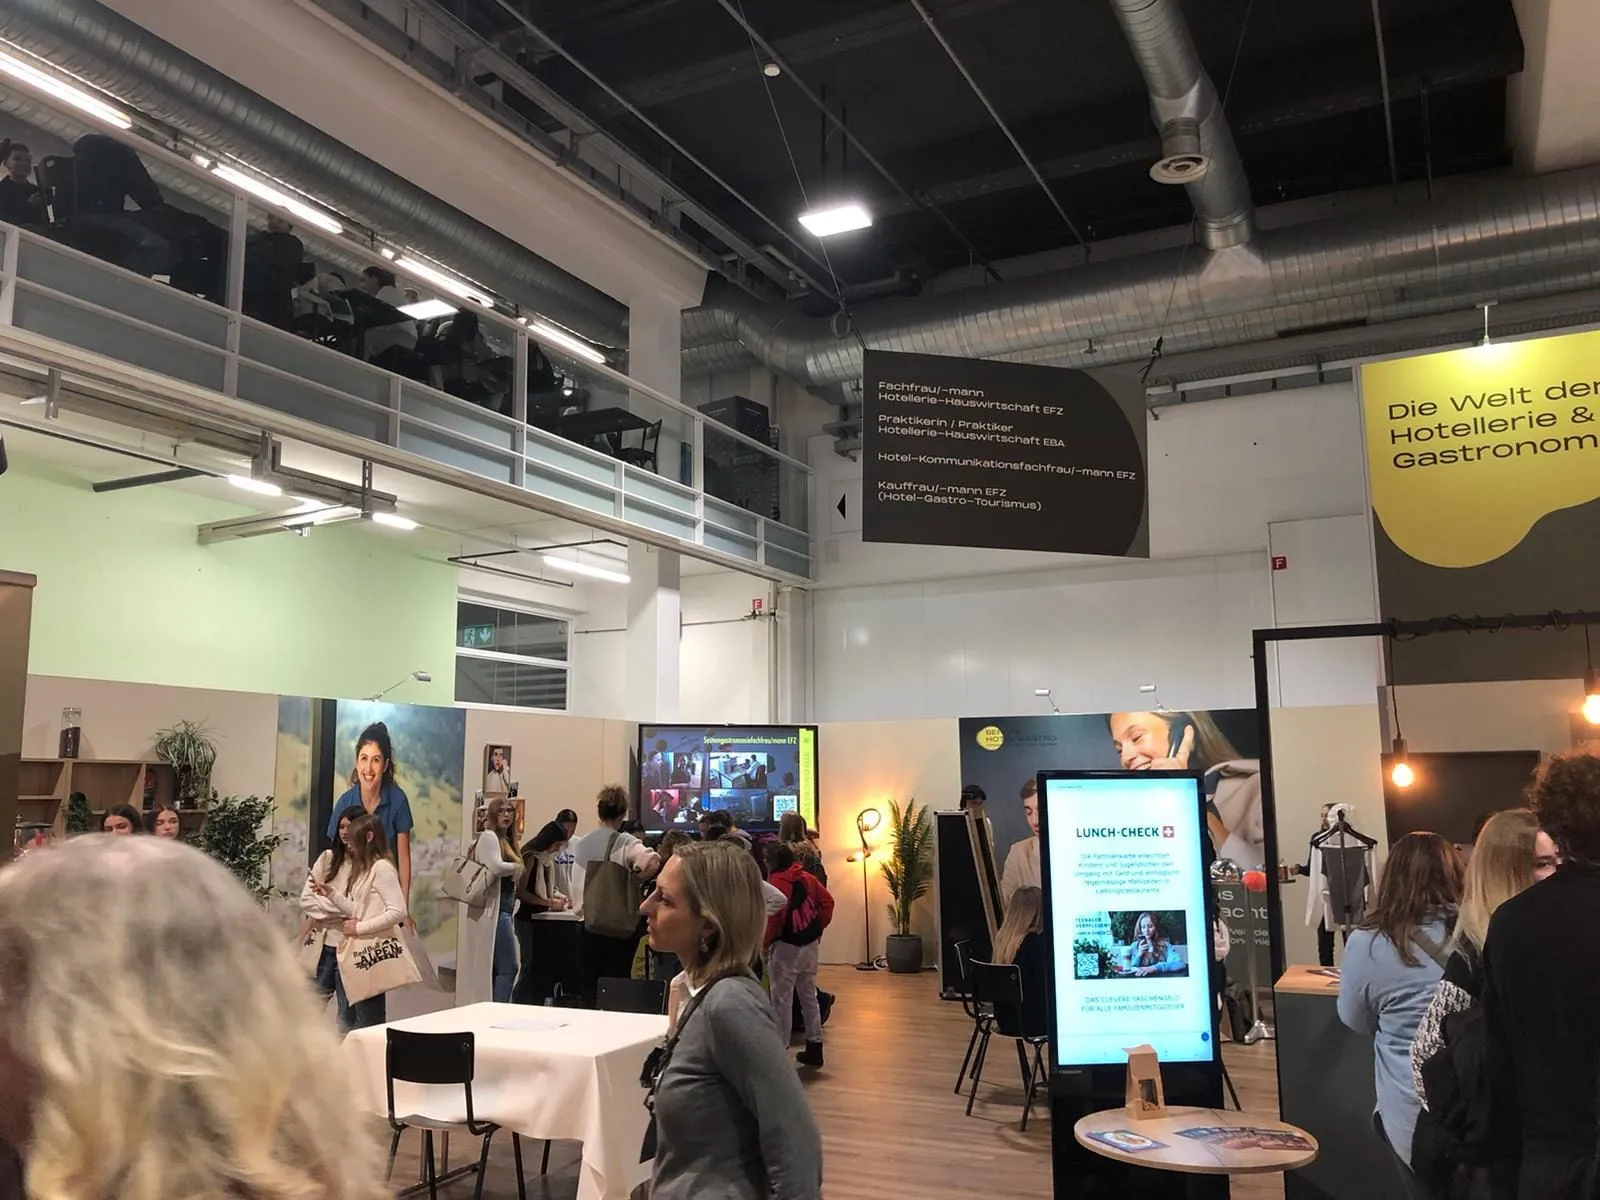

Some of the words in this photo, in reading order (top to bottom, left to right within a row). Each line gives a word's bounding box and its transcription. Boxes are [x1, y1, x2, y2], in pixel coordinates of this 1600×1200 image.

[878, 381, 984, 398] Fachfrau/-mann
[878, 391, 1041, 415] Hotellerie-Hauswirtschaft
[1043, 406, 1064, 416] EFZ
[1388, 401, 1438, 420] Die
[1450, 387, 1533, 412] Welt
[878, 414, 947, 428] Praktikerin
[958, 420, 1014, 433] Praktiker
[1391, 411, 1557, 445] Hotellerie
[1571, 406, 1595, 424] &
[878, 425, 1041, 446] Hotellerie-Hauswirtschaft
[1043, 438, 1065, 448] EBA
[1393, 433, 1599, 469] Gastronom
[878, 452, 1114, 478] Hotel-Kommunikationsfachfrau/-mann
[1116, 470, 1136, 480] EFZ
[878, 481, 983, 496] Kauffrau/-mann
[985, 487, 1007, 497] EFZ
[878, 492, 1042, 512] (Hotel-Gastro-Tourismus)
[1076, 827, 1159, 838] LUNCH-CHECK
